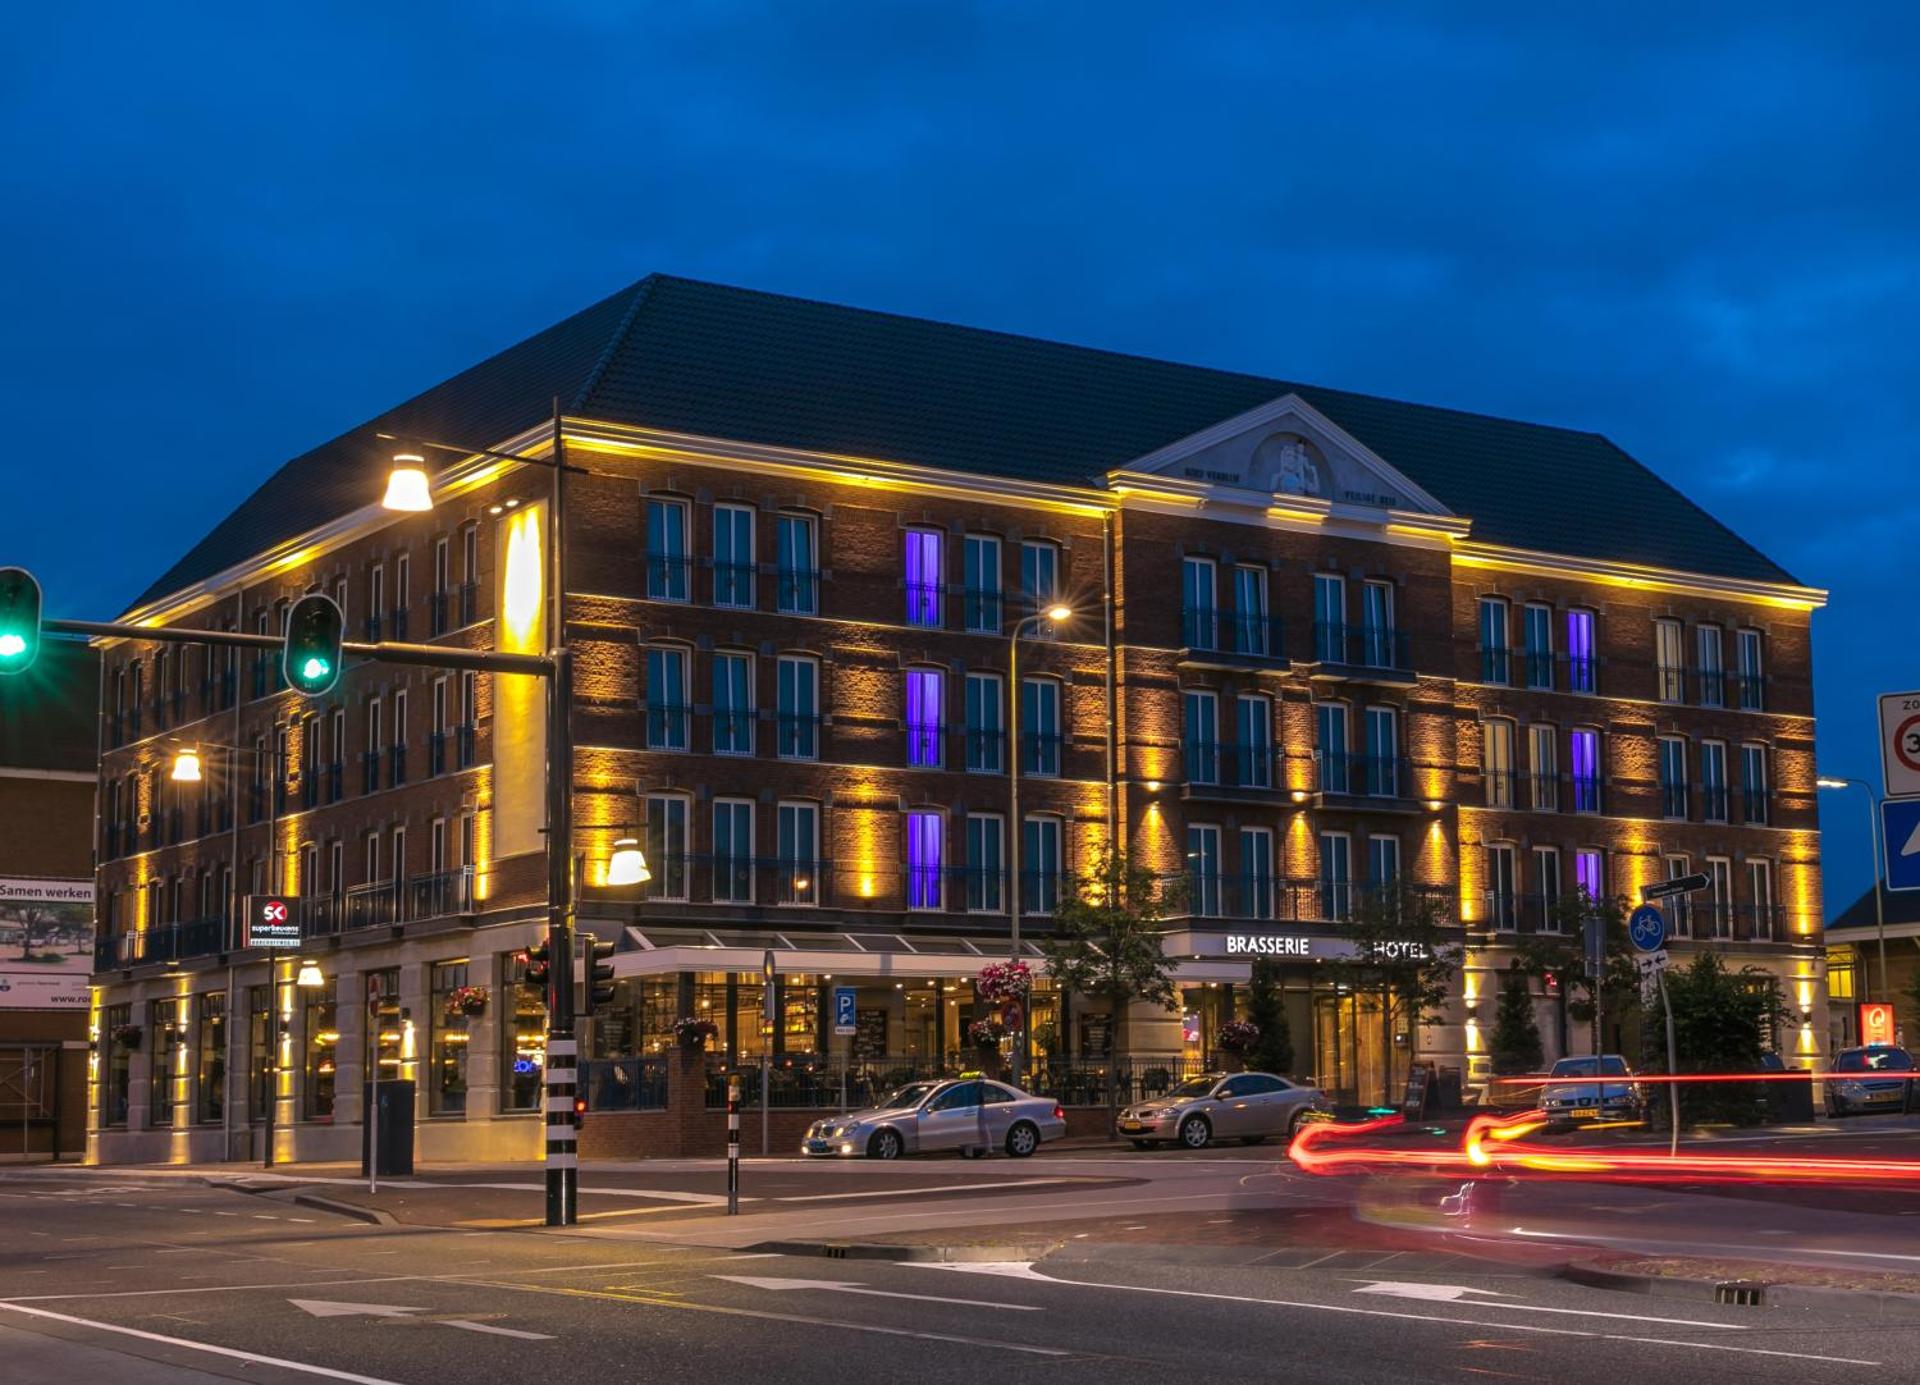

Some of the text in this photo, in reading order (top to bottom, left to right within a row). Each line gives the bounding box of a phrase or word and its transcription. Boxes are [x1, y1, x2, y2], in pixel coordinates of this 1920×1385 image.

[0, 884, 92, 899] Samen werken
[1226, 935, 1309, 955] BRASSERIE
[1373, 941, 1429, 959] HOTEL
[840, 996, 851, 1013] P
